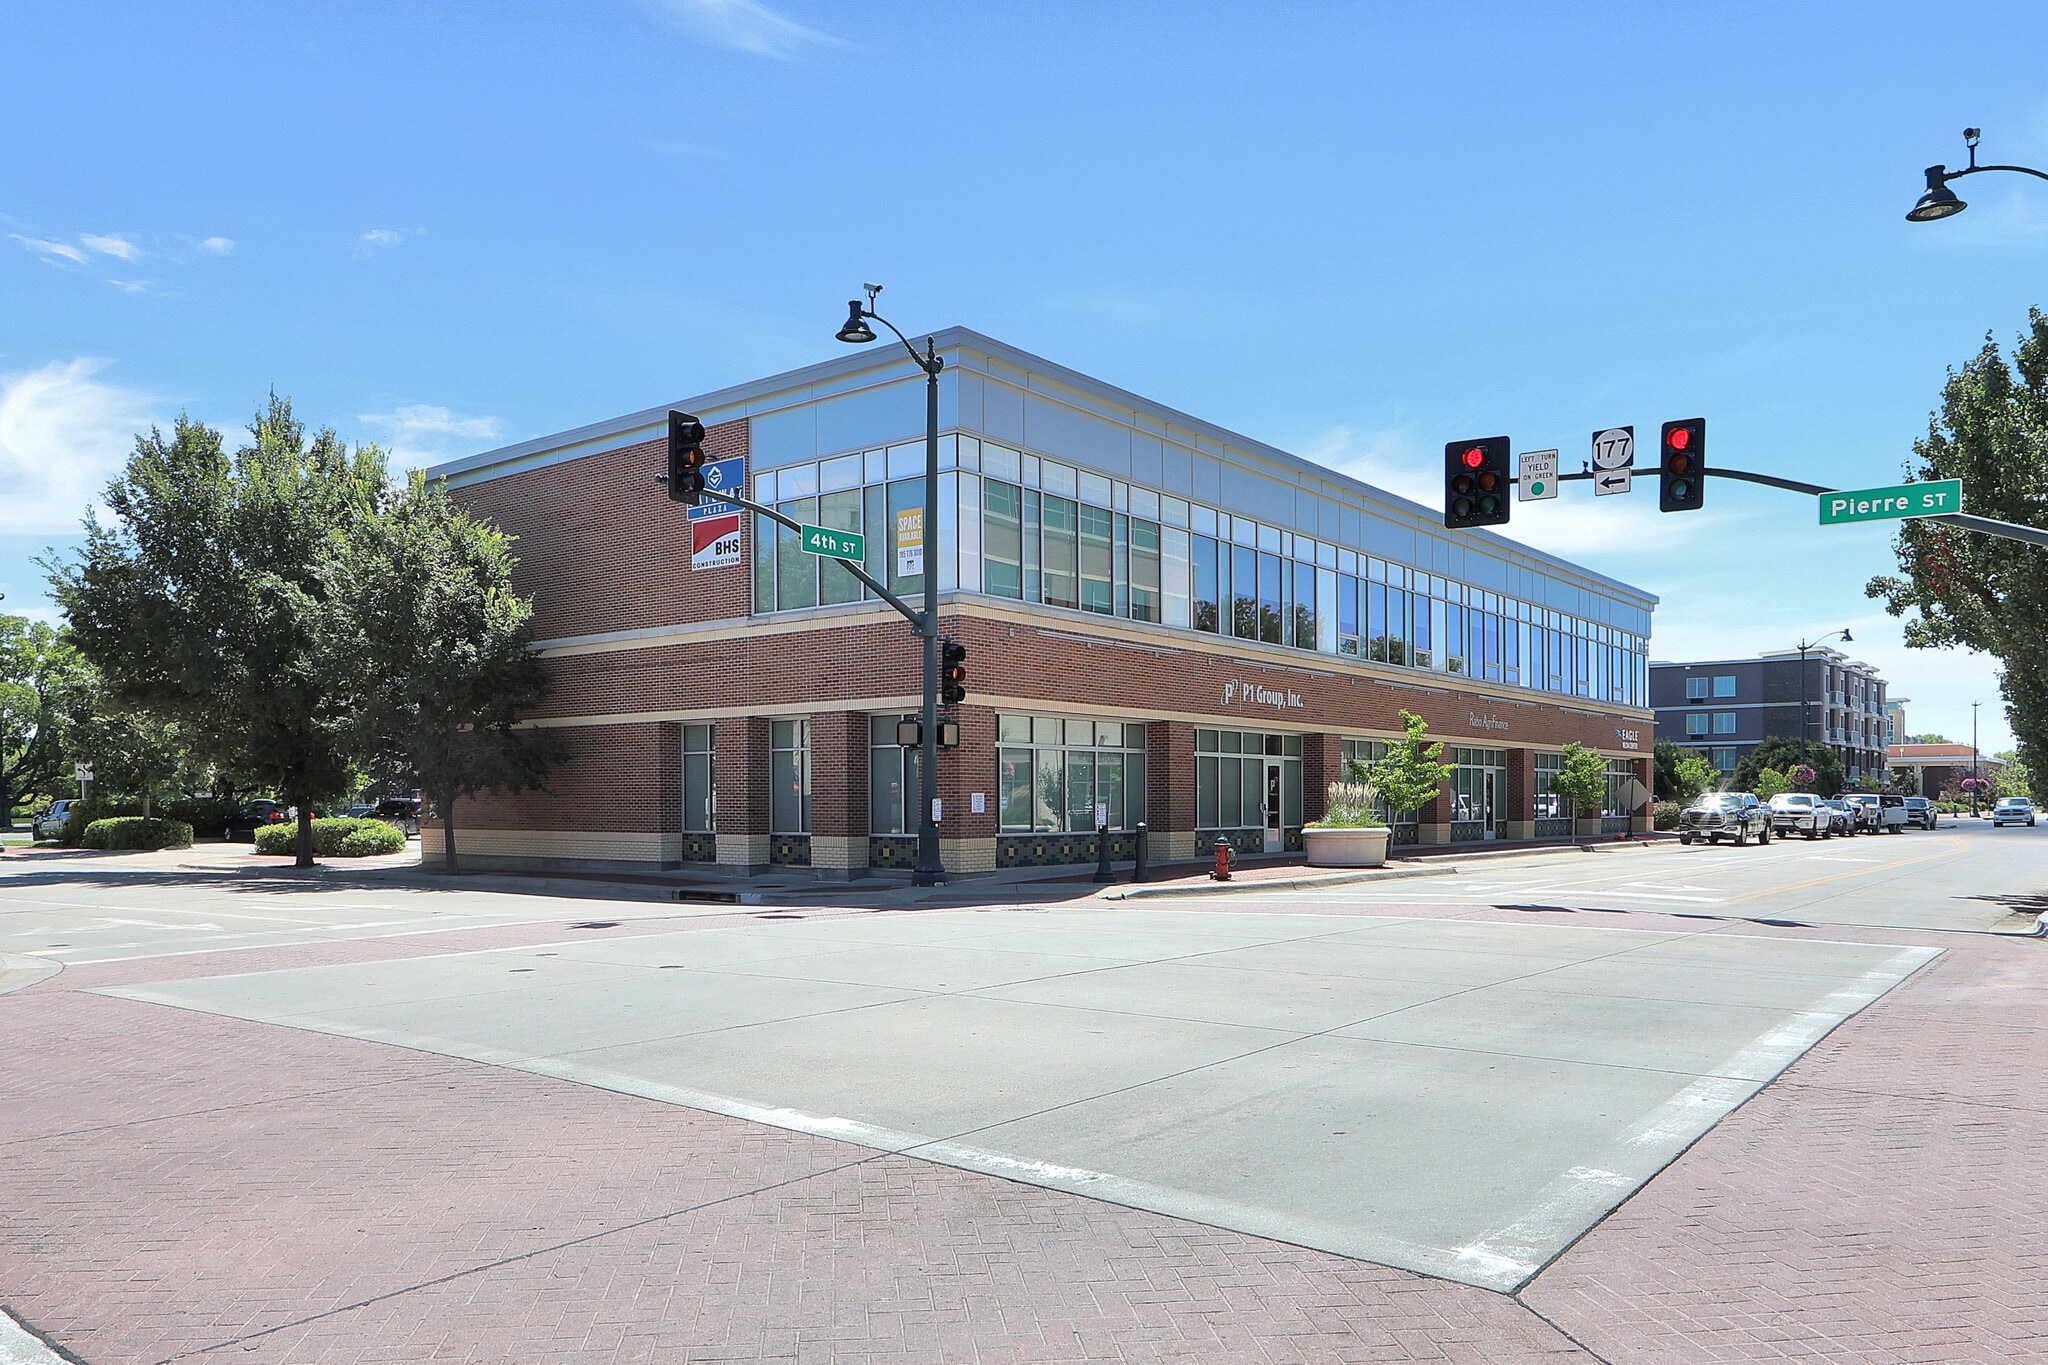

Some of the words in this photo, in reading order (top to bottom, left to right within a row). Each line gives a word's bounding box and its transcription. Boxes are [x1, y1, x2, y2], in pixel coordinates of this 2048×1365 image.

[1596, 437, 1630, 460] 177
[1528, 462, 1549, 472] YIELD
[1535, 472, 1553, 480] GREEN
[703, 504, 728, 515] PLAZA
[1831, 496, 1909, 517] Pierre
[1922, 492, 1947, 508] ST
[899, 514, 922, 532] SPACE
[899, 530, 922, 541] AVAILABLE
[715, 539, 739, 555] BHS
[811, 533, 836, 551] 4th
[842, 542, 856, 554] ST
[693, 557, 739, 568] CONSTRUCTION
[1243, 683, 1254, 702] P1
[1256, 685, 1286, 710] Group,
[1287, 688, 1304, 707] Inc.
[1622, 729, 1638, 741] EAGLE
